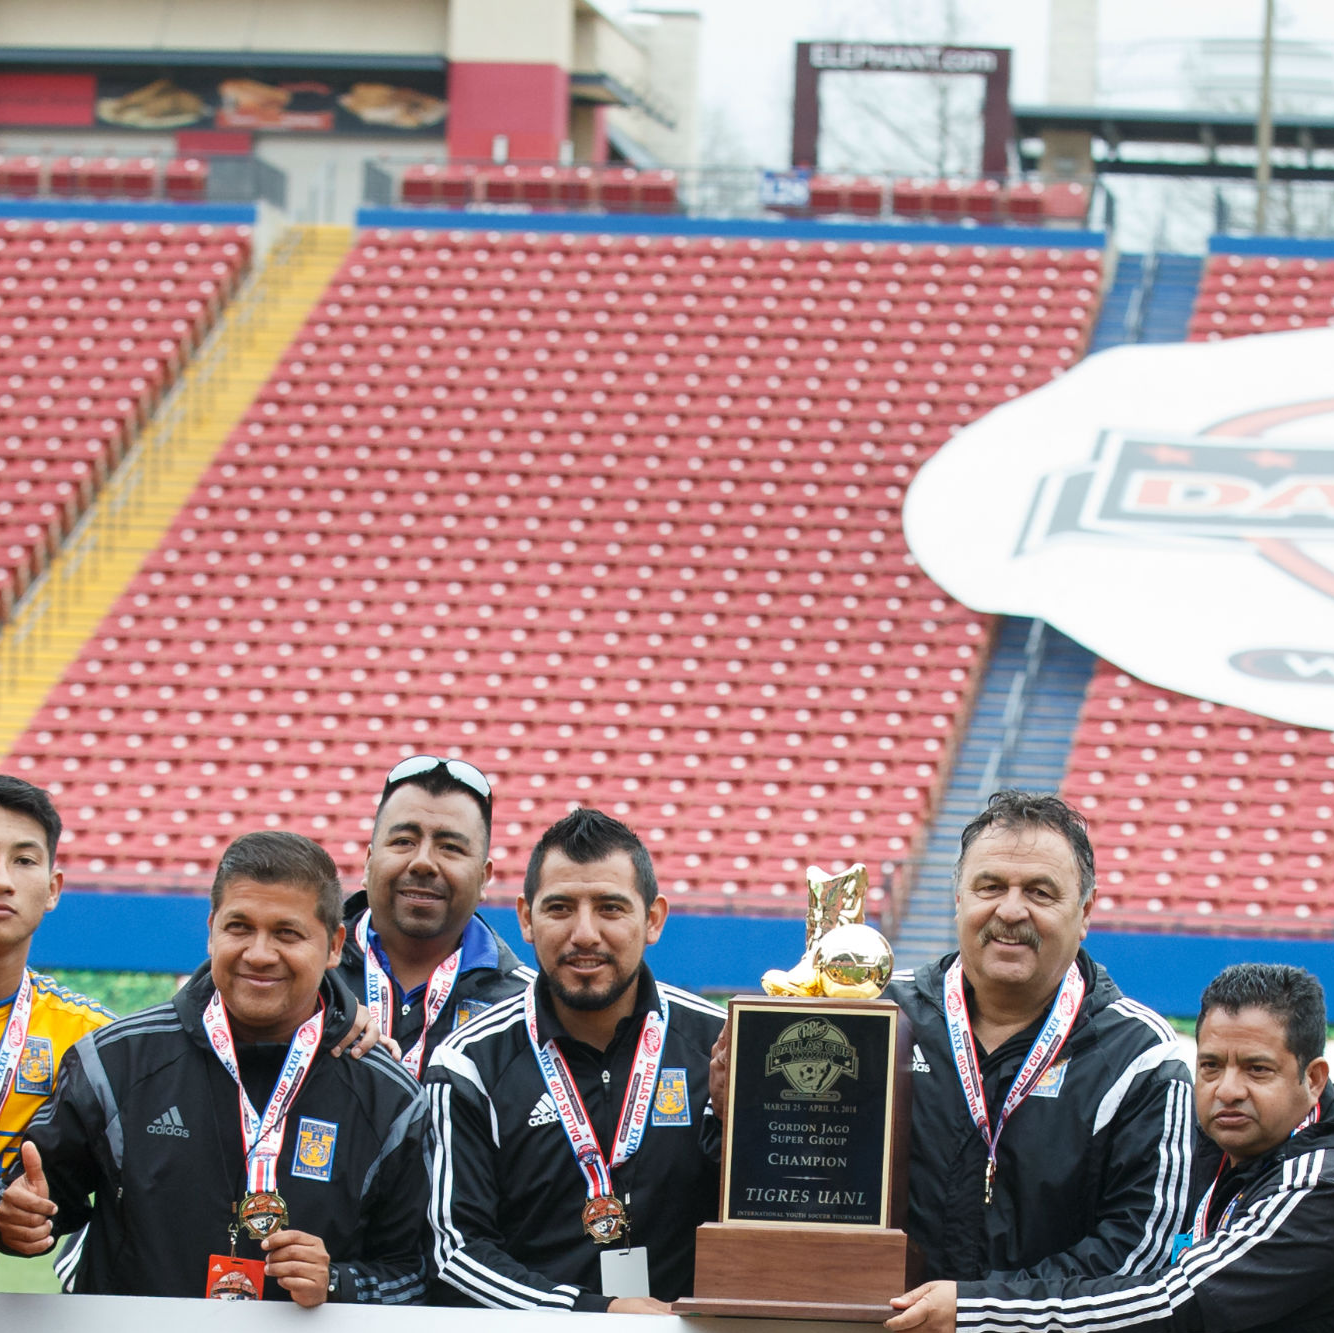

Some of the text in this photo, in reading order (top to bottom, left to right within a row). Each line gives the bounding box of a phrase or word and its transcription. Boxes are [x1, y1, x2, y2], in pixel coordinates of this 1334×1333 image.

[949, 1021, 963, 1052] XXXIX
[773, 1039, 855, 1059] DALLAS CUP
[284, 1048, 303, 1080] XXXIX
[539, 1048, 557, 1078] XXXIX
[1006, 1062, 1034, 1106] DALLAS
[1040, 1015, 1062, 1046] XXXIX
[960, 1077, 980, 1117] DALLAS
[625, 1063, 655, 1158] DALLAS CUP XXXIX
[763, 1102, 792, 1112] MARCH
[808, 1104, 828, 1114] APRIL
[146, 1121, 191, 1139] adidas
[560, 1101, 582, 1143] DALLAS
[769, 1121, 850, 1134] GORDON JAGO
[770, 1133, 847, 1146] SUPER GROUP
[768, 1152, 848, 1169] CHAMPION
[746, 1187, 867, 1206] TIGRES UANL
[737, 1210, 784, 1218] INTERNATIONAL
[786, 1211, 807, 1219] YOUTH
